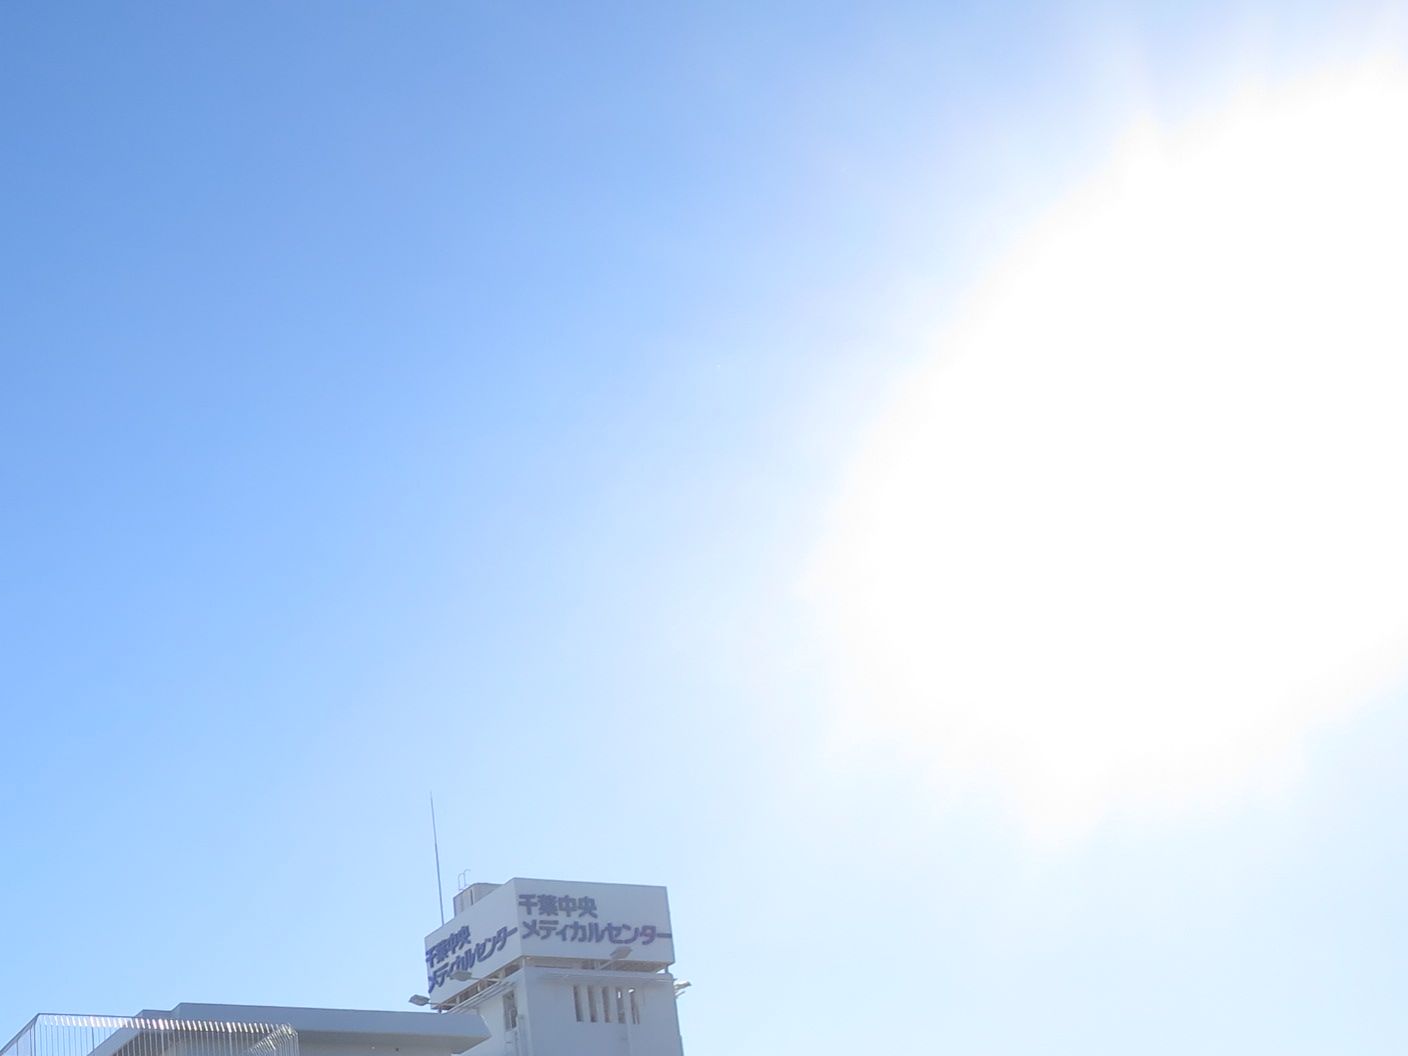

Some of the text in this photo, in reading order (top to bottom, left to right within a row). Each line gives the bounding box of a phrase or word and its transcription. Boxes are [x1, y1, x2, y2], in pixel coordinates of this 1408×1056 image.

[518, 894, 598, 918] 千葉中央
[522, 919, 672, 945] メディカルセンター
